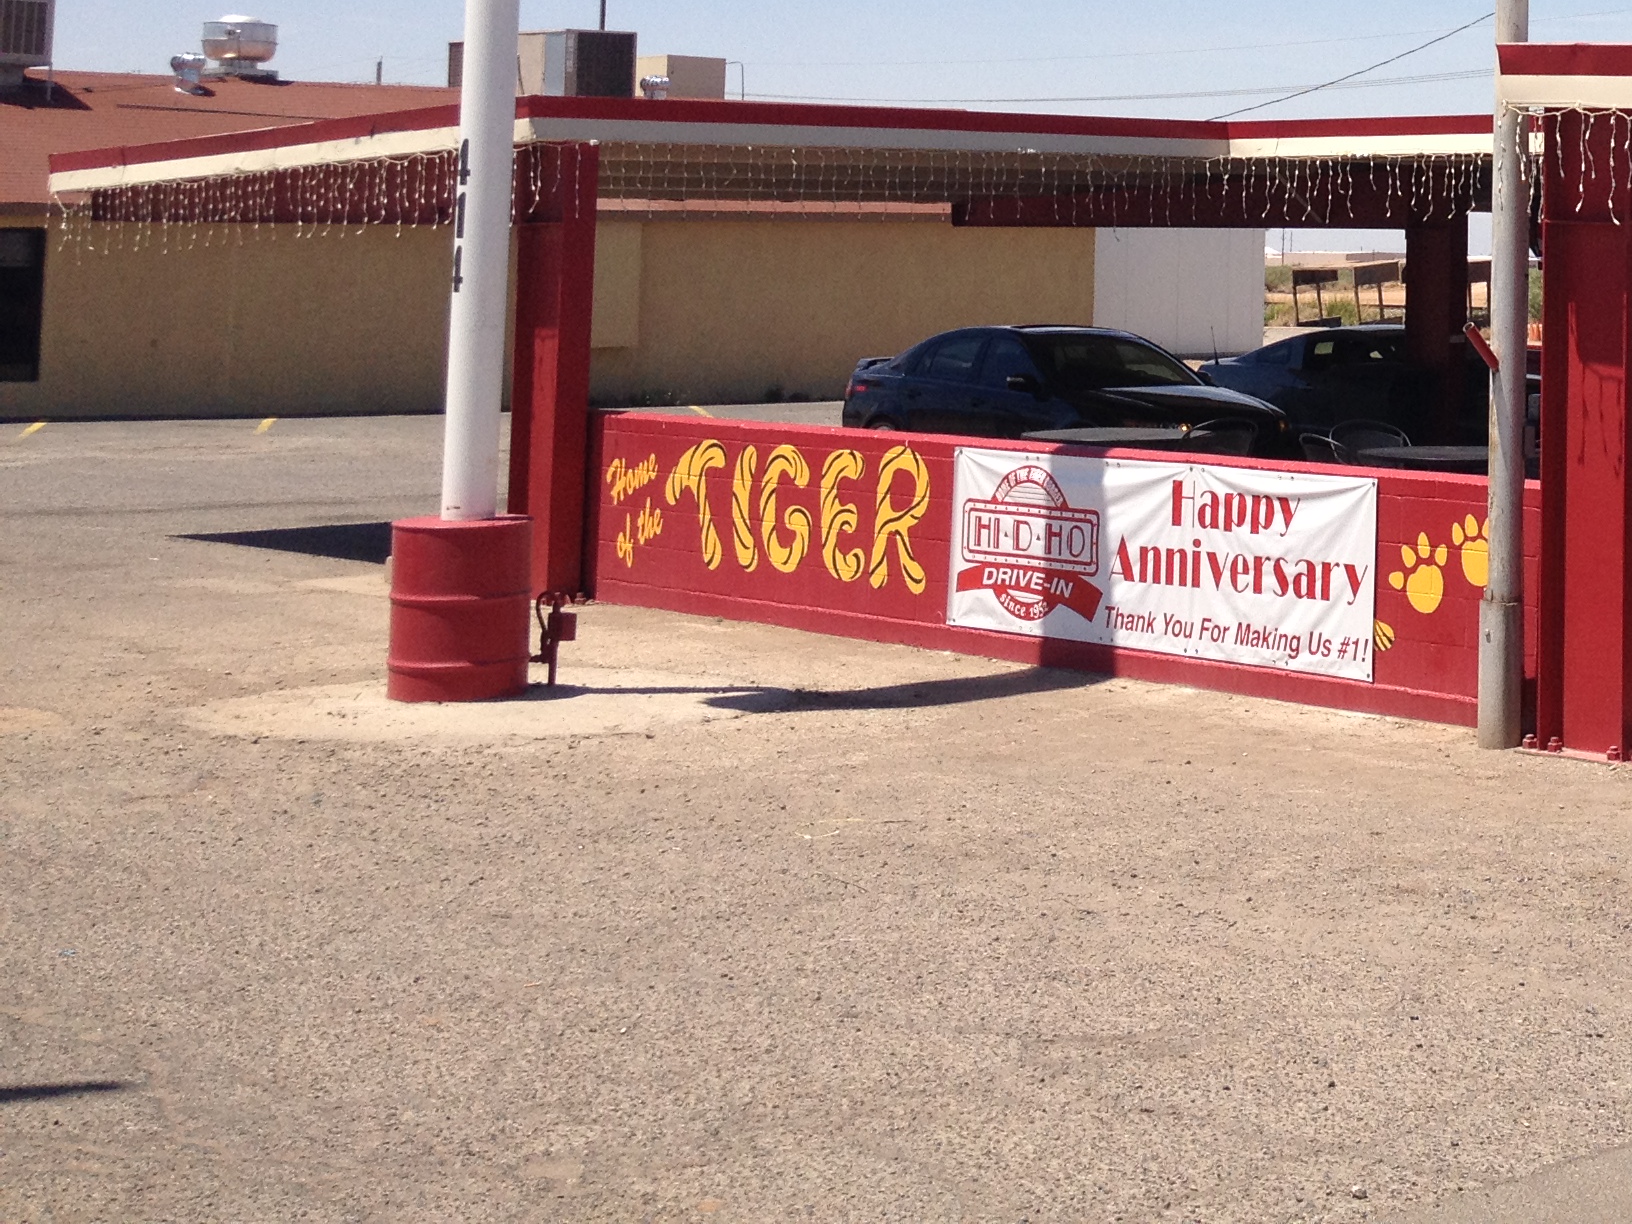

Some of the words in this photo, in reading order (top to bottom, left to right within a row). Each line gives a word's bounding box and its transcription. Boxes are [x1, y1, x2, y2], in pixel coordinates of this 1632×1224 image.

[606, 453, 658, 505] Home
[1171, 479, 1301, 537] Happy
[617, 512, 634, 568] of
[637, 496, 663, 545] the
[665, 439, 930, 595] TIGER
[982, 567, 1074, 599] DRIVE-IN
[1108, 534, 1368, 606] Anniversary
[1000, 594, 1026, 616] since
[1104, 605, 1157, 634] Thank
[1163, 613, 1195, 639] You
[1199, 617, 1230, 645] For
[1234, 622, 1301, 660] Making
[1308, 631, 1332, 657] Us
[1337, 636, 1369, 663] #1!
